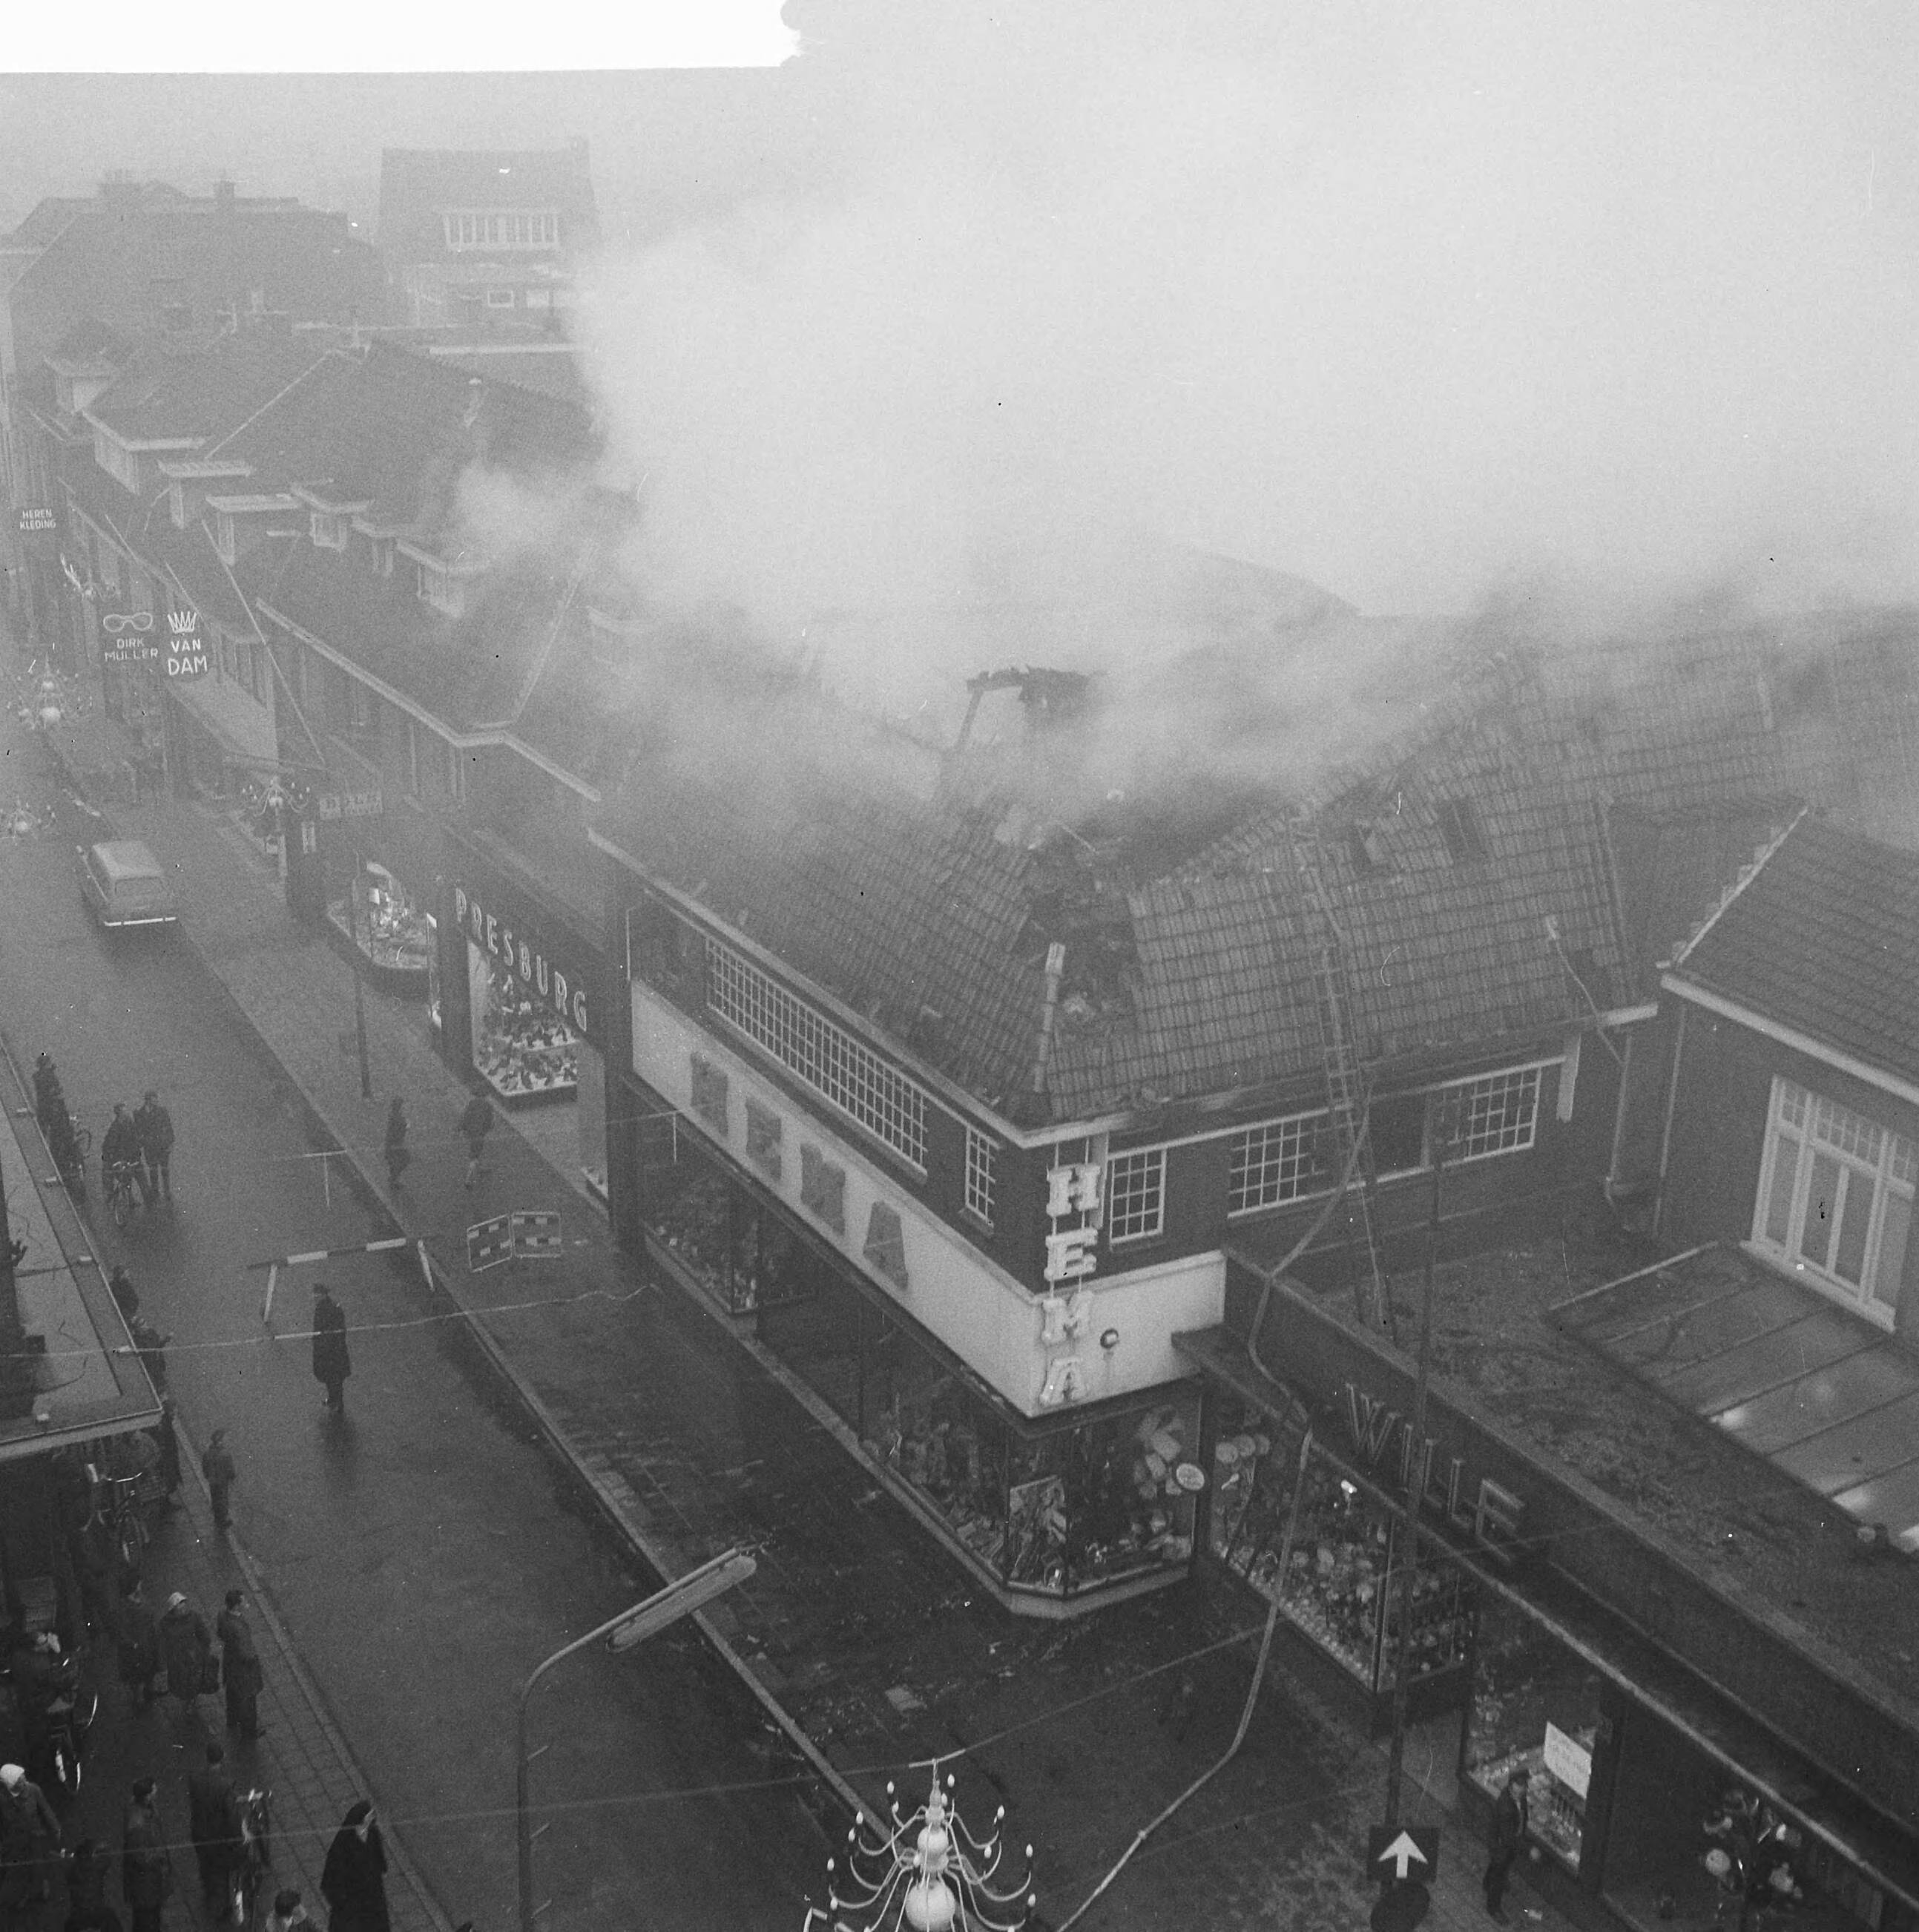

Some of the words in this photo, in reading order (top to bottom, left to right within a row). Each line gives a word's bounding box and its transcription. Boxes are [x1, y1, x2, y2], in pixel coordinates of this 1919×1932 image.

[116, 637, 145, 649] DIRK
[167, 655, 208, 676] DAM
[171, 638, 202, 653] VAN
[455, 887, 587, 1032] PRESBURG
[1039, 1163, 1102, 1406] HEMA
[1345, 1383, 1525, 1564] WILLE
